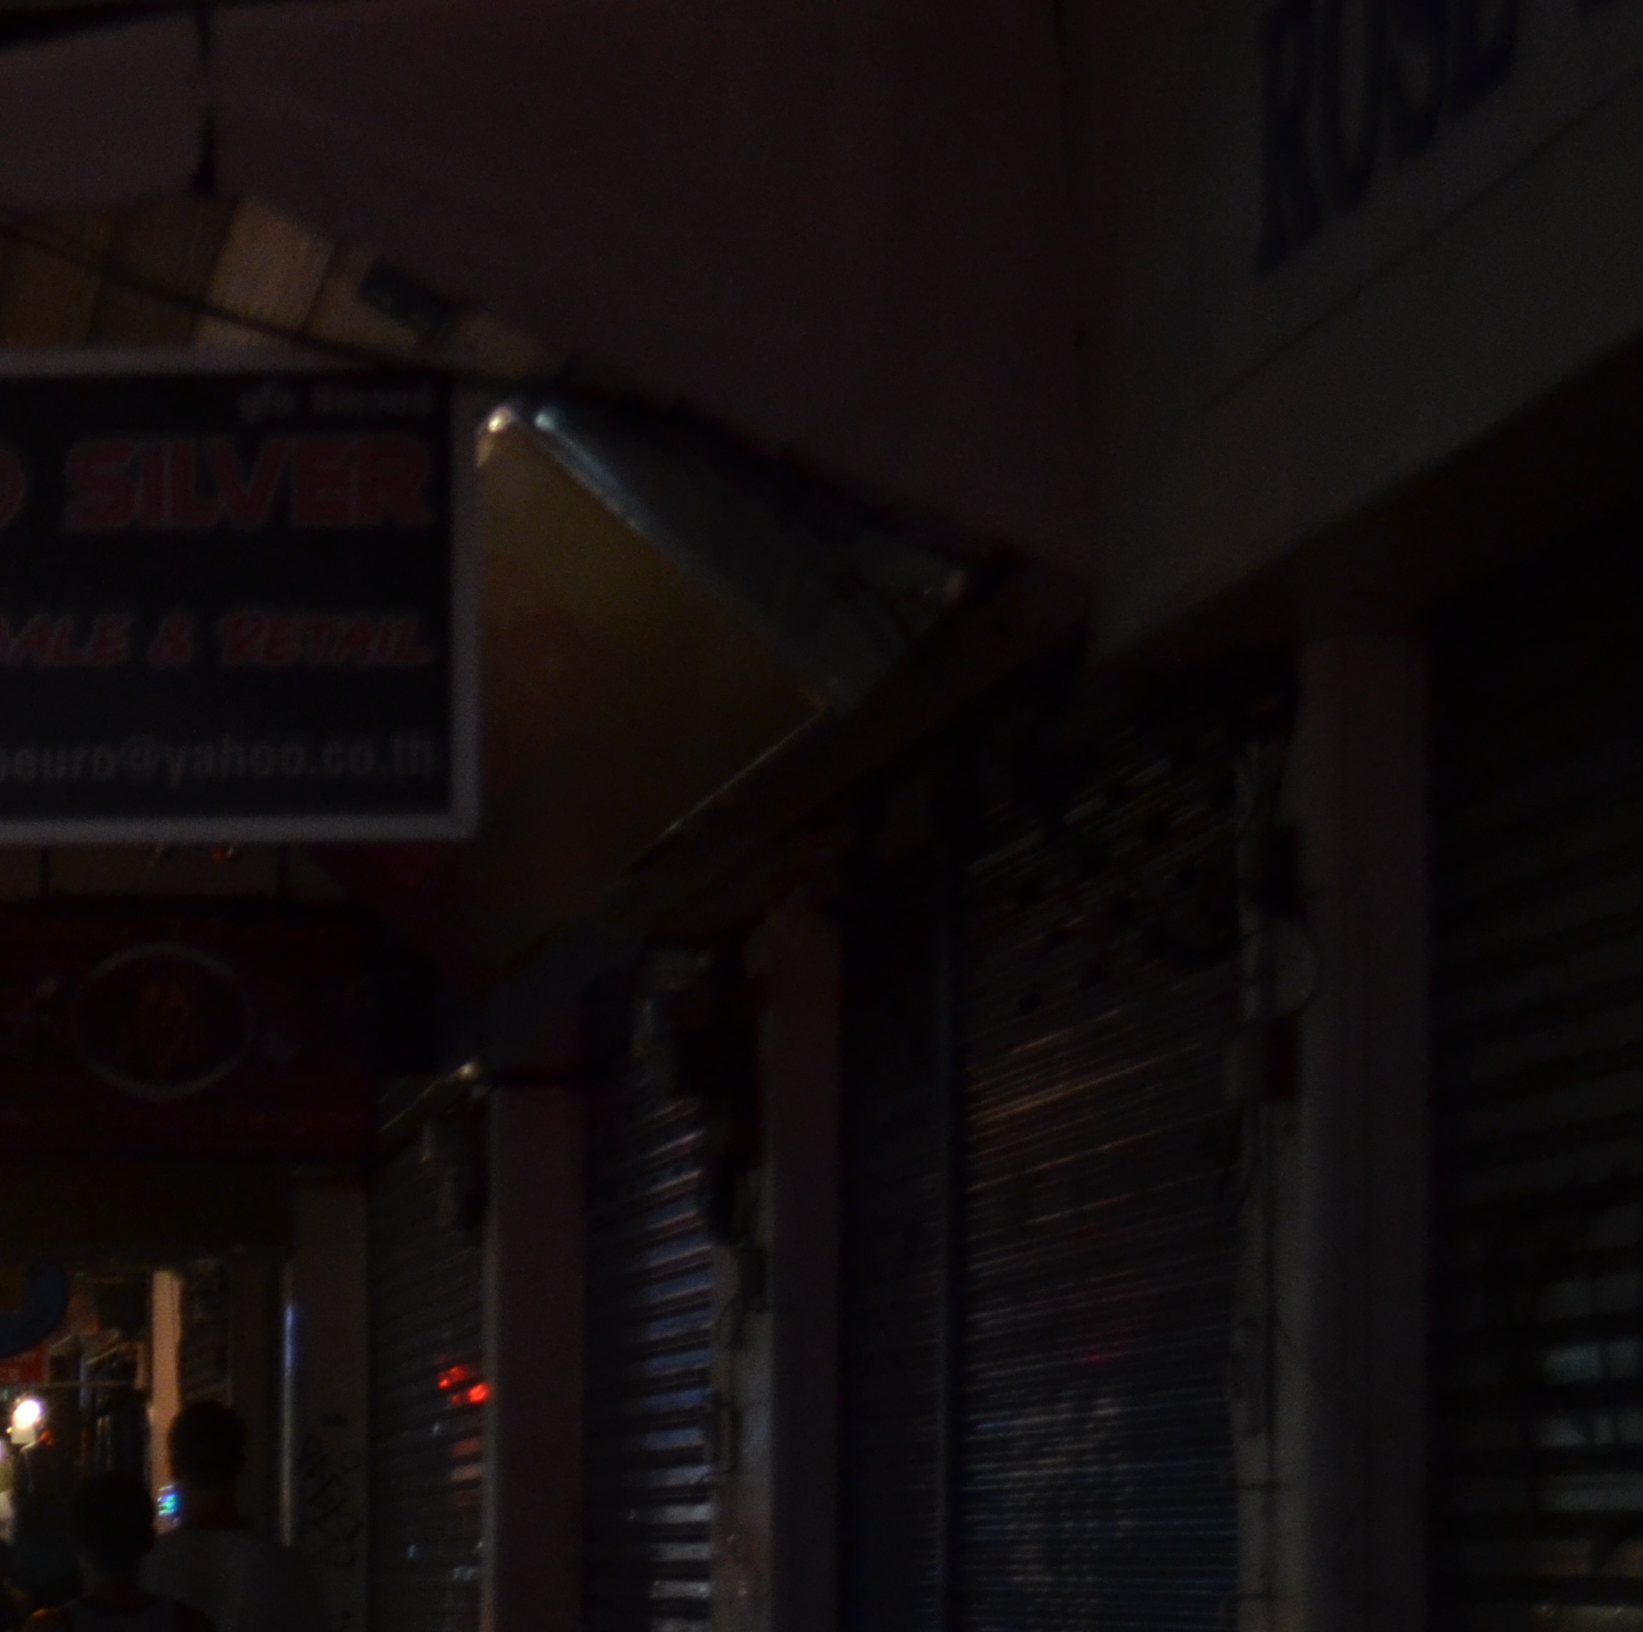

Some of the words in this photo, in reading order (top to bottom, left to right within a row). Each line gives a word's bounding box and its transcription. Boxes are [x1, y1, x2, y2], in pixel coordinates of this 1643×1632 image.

[62, 431, 438, 531] SILVER
[146, 612, 194, 669] &
[216, 608, 437, 669] RETAIL
